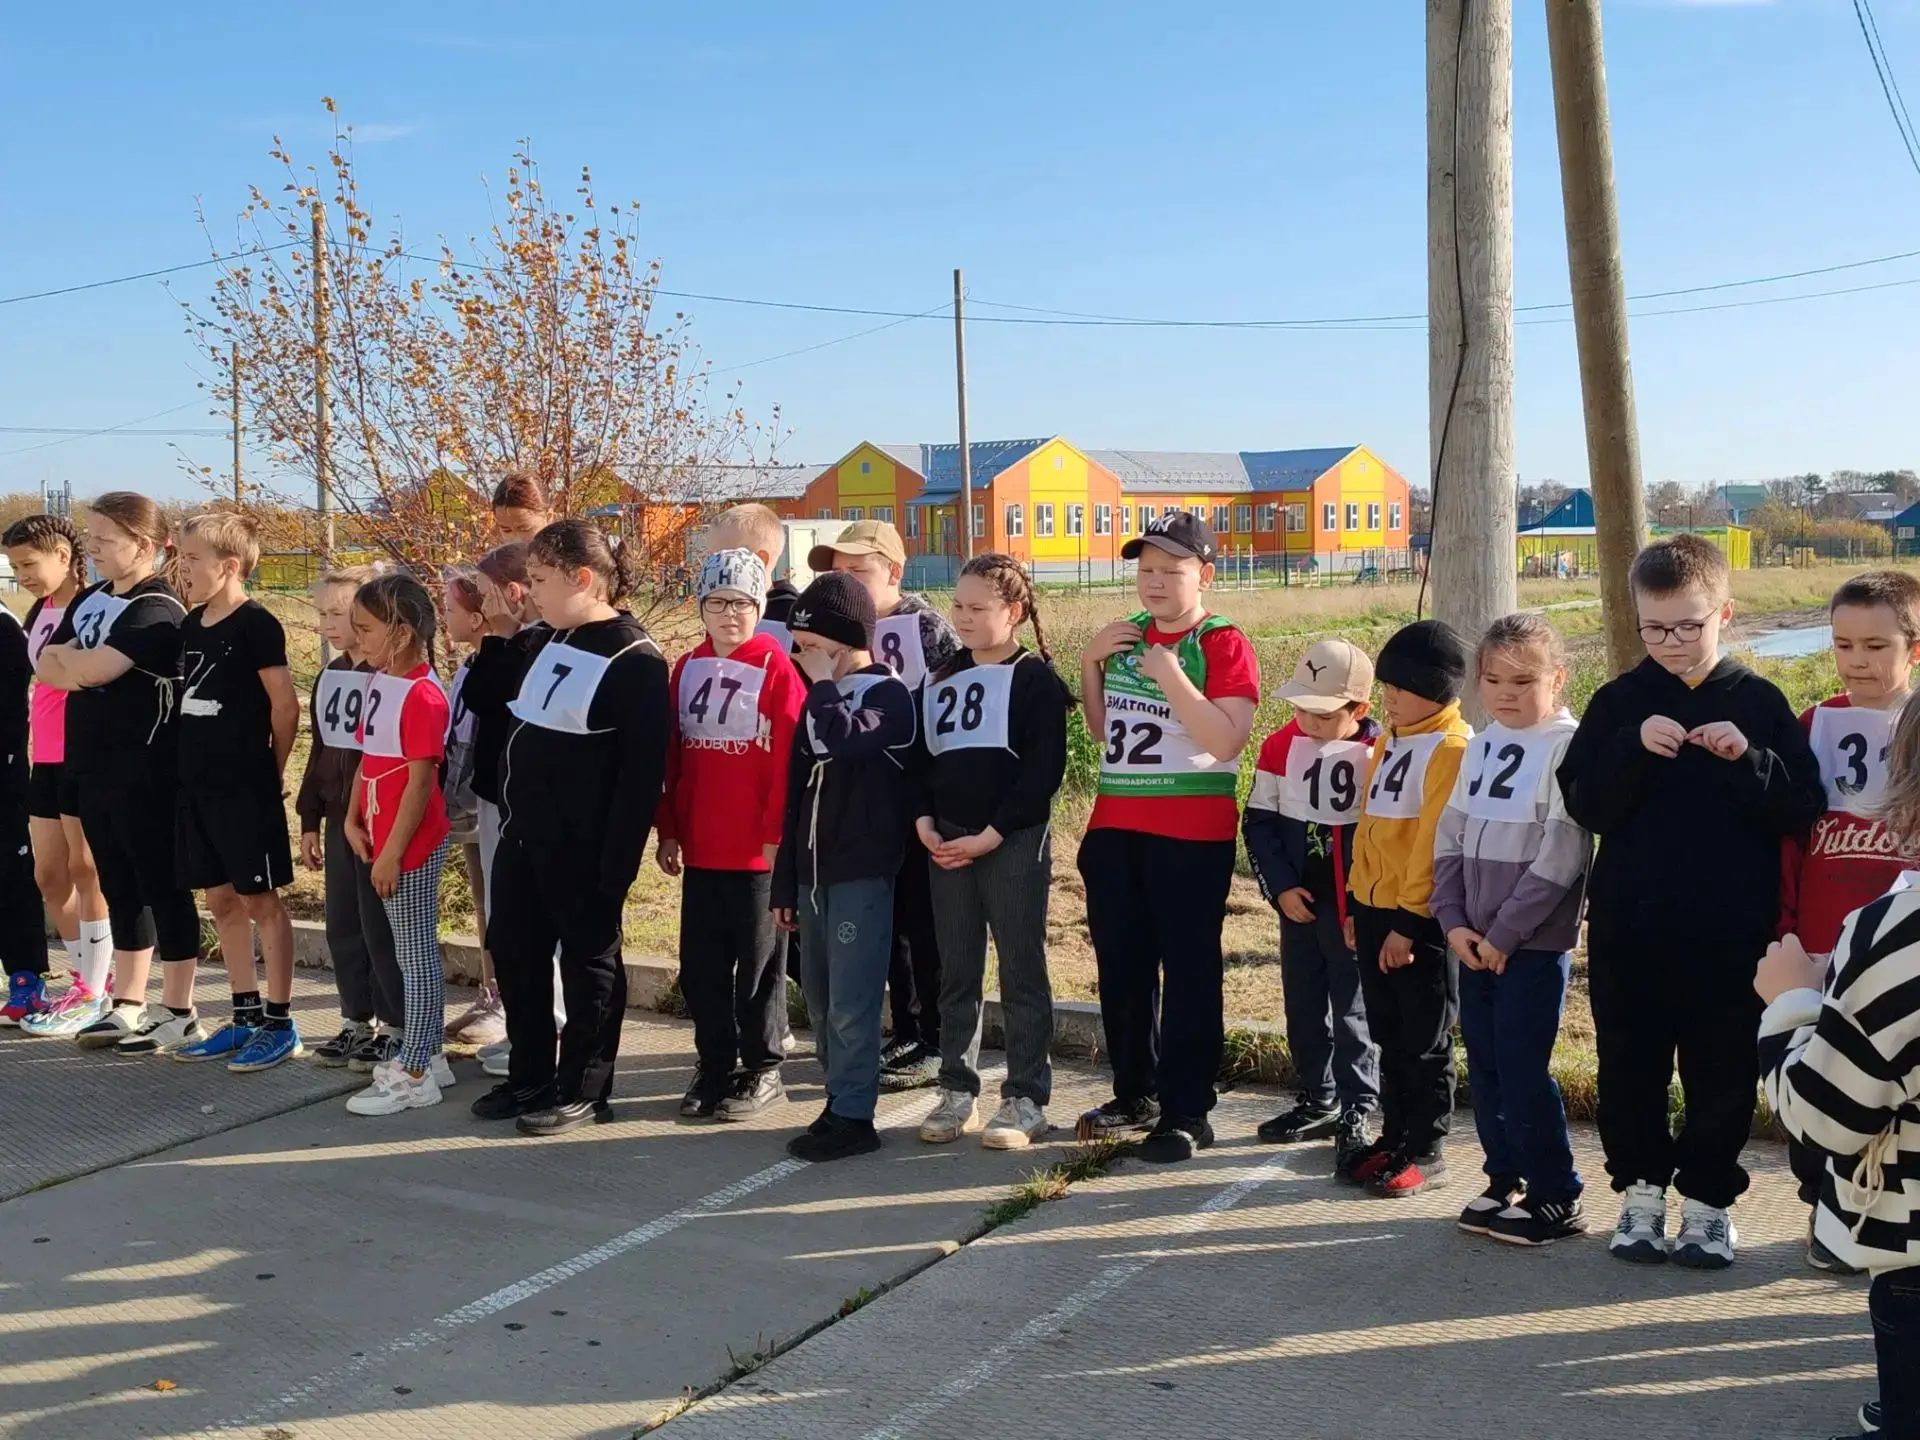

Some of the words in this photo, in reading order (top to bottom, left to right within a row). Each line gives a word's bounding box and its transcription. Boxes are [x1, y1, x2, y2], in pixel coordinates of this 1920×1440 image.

[79, 609, 106, 650] 73
[325, 687, 363, 733] 49
[542, 662, 573, 711] 7
[689, 677, 742, 725] 47
[936, 682, 985, 737] 28
[1105, 719, 1163, 765] 32
[1303, 757, 1357, 812] 19
